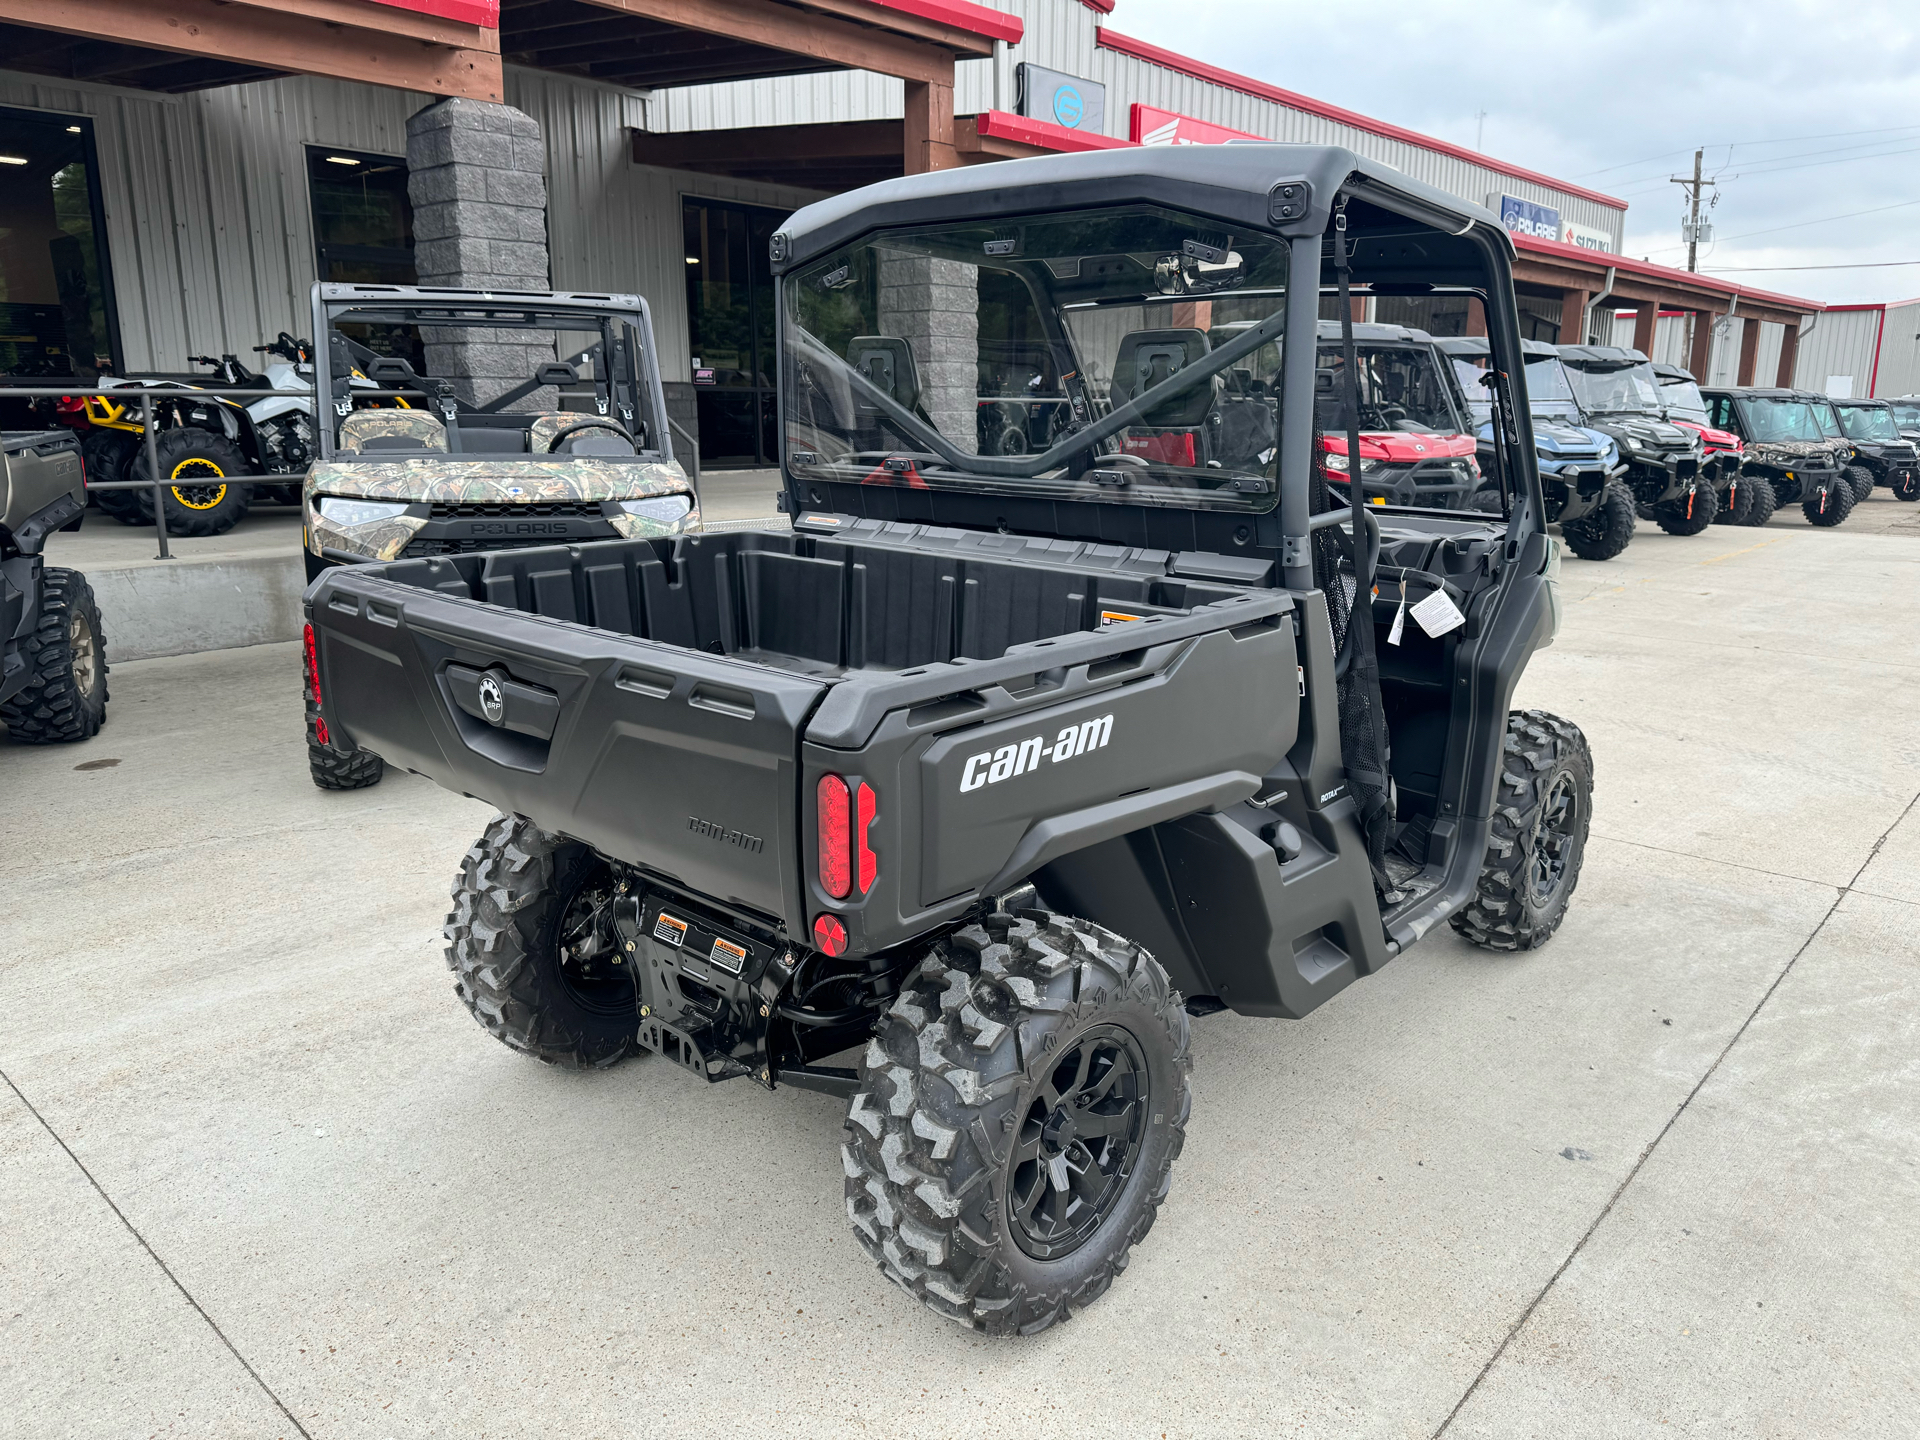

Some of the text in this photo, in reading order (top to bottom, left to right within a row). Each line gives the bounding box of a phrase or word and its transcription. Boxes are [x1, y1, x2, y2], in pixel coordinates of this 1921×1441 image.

[1517, 217, 1558, 241] POLARIS
[1576, 234, 1610, 253] SUZUKI
[470, 522, 568, 535] POLARIS
[487, 701, 501, 710] BRP
[959, 714, 1114, 793] can-am
[1320, 789, 1338, 804] ROTAX
[687, 815, 764, 854] can-am
